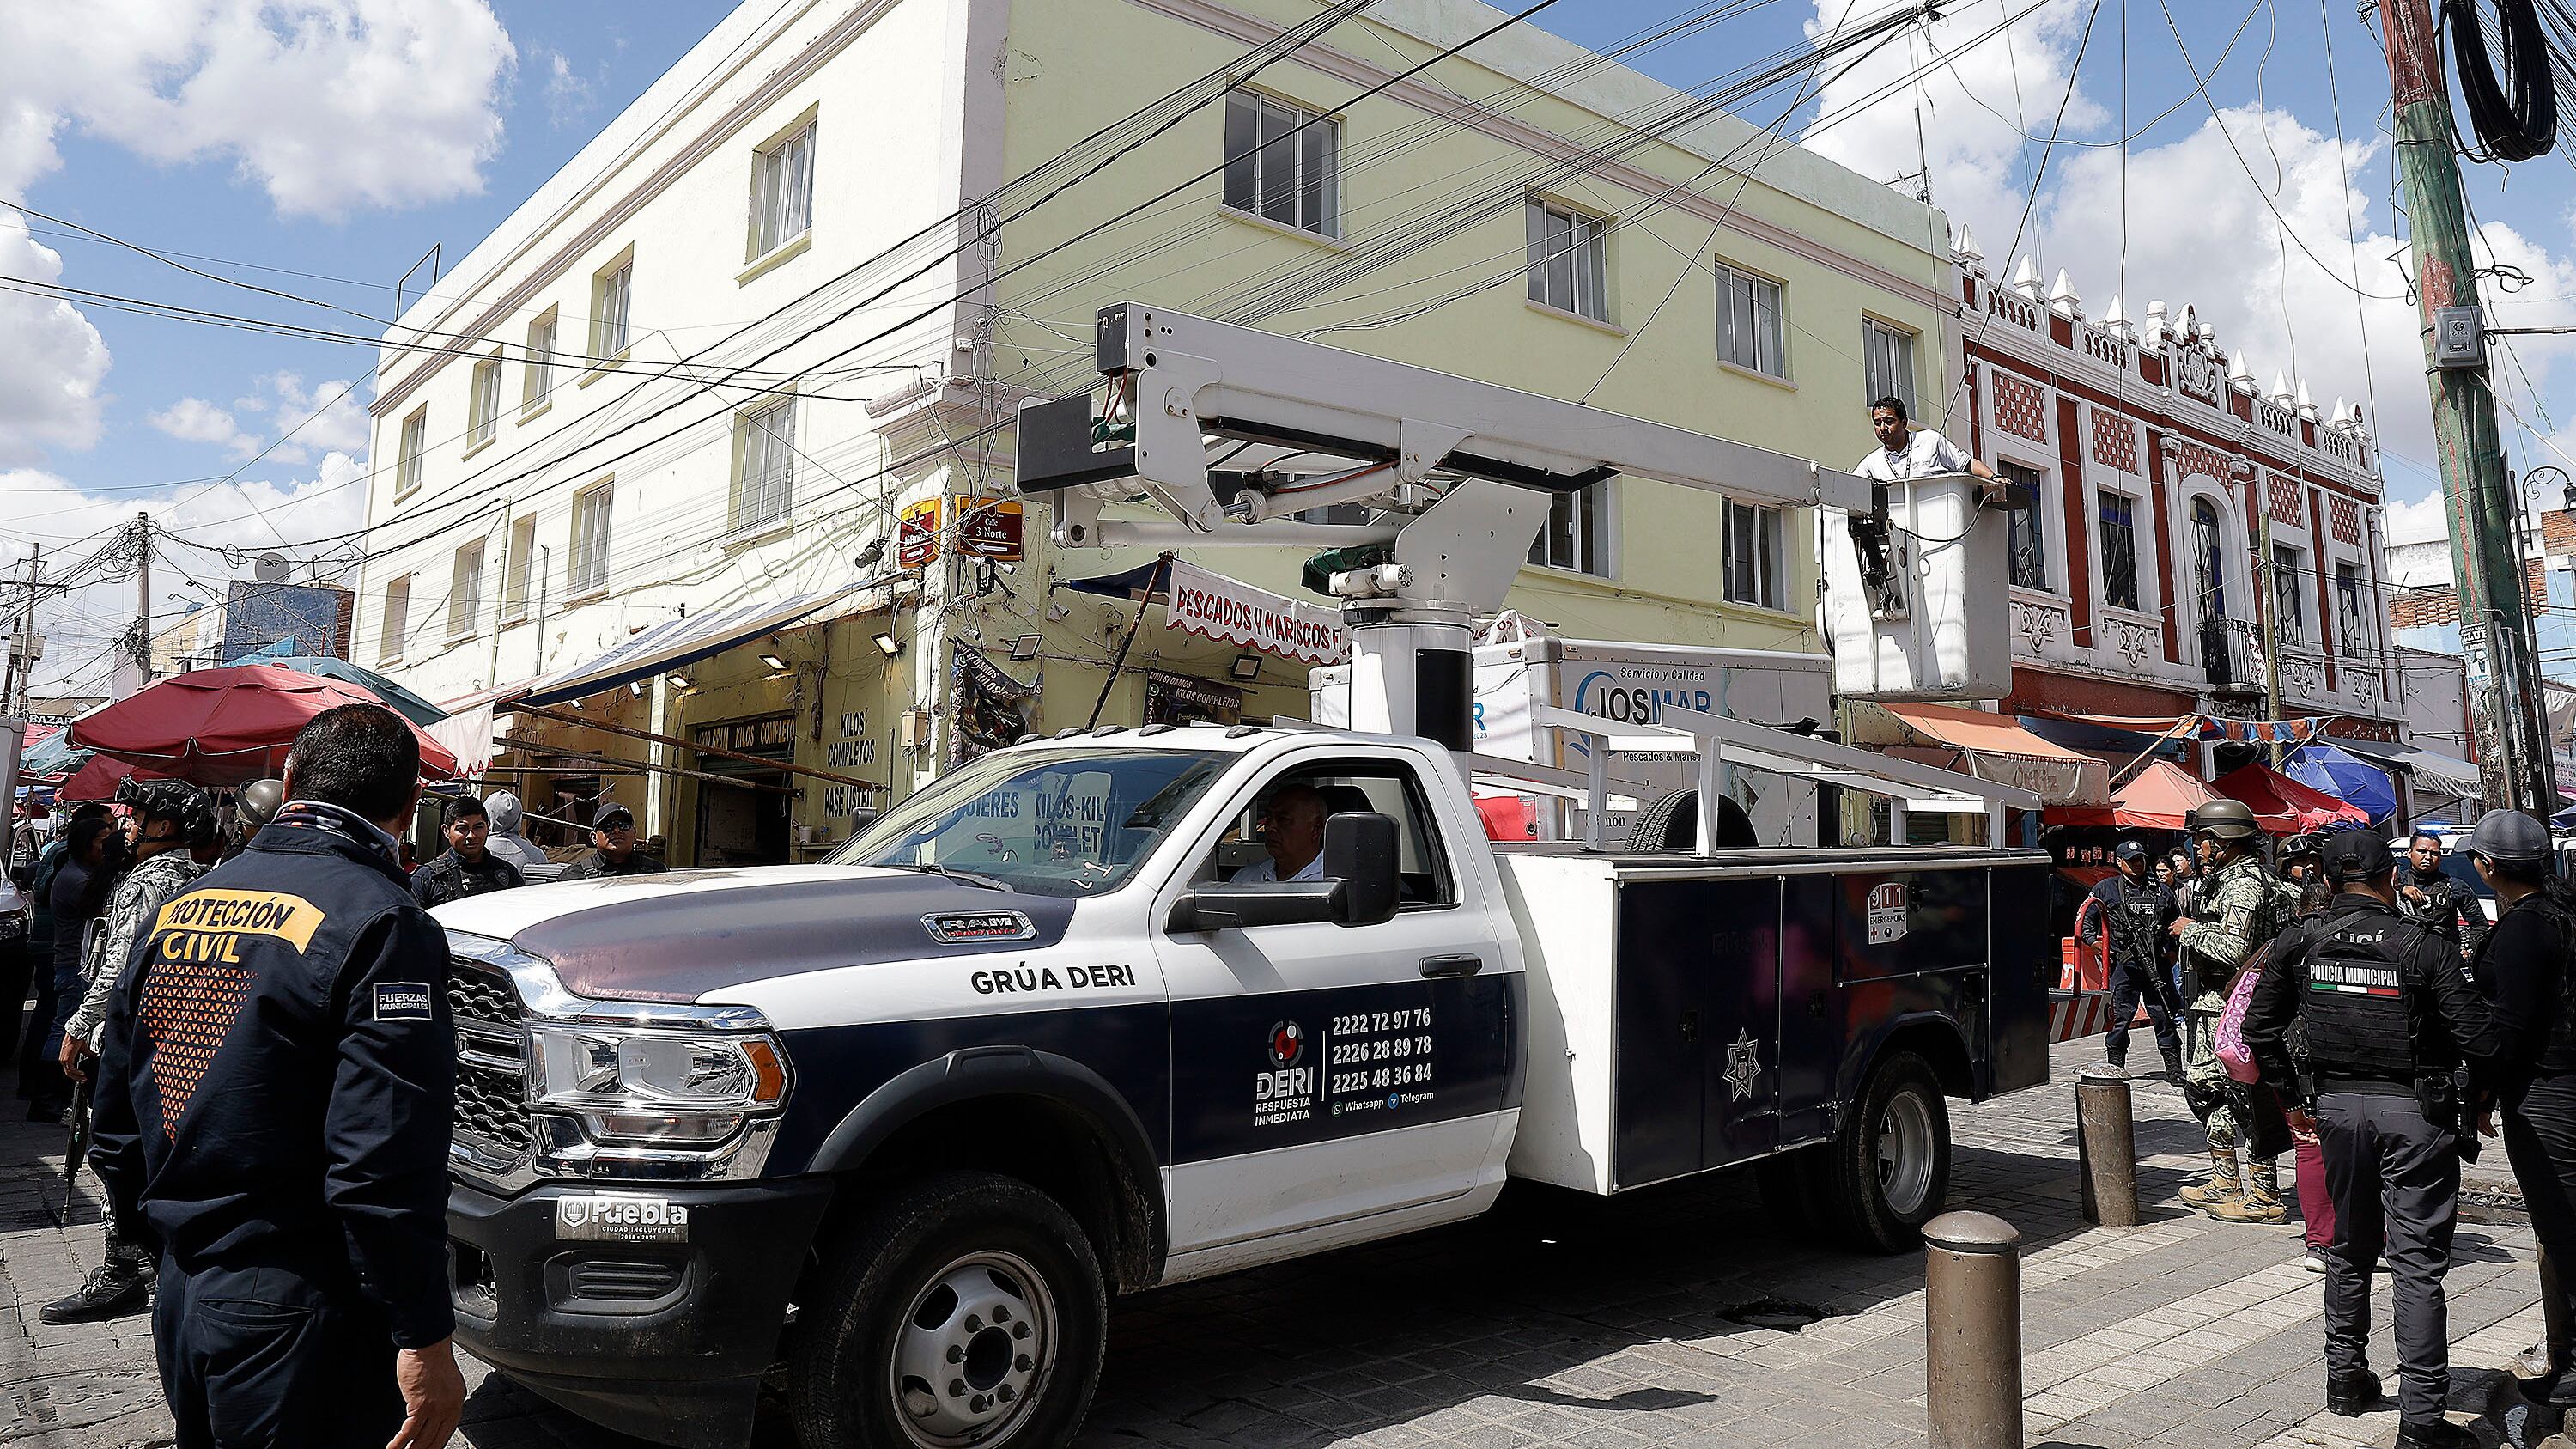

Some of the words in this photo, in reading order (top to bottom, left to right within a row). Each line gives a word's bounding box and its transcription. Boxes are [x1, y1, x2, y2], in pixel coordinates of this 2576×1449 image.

[975, 527, 981, 537] 3
[984, 527, 1007, 539] Norte
[985, 518, 999, 527] Calle
[1176, 584, 1252, 631] PESCADOS
[1254, 606, 1262, 636] Y
[1265, 610, 1331, 650] MARISCOS
[1620, 667, 1660, 679] Servicio
[1662, 671, 1668, 682] y
[1671, 668, 1705, 681] Calidad
[1176, 688, 1197, 701] KILOS
[1196, 692, 1240, 709] COMPLETOS
[840, 710, 865, 738] KILOS
[735, 724, 755, 749] KILOS
[827, 739, 876, 768] COMPLETOS
[1623, 752, 1663, 762] Pescados
[1666, 752, 1673, 762] &
[824, 786, 844, 817] PASE
[1870, 886, 1902, 907] 911
[942, 917, 1012, 929] RAM
[1869, 914, 1905, 925] EMERGENCIAS
[162, 931, 240, 964] CIVIL
[970, 961, 1063, 995] GRÚA
[1066, 965, 1136, 989] DERI
[2310, 961, 2344, 983] POLICÍA
[2345, 966, 2399, 987] MUNICIPAL
[379, 993, 428, 1004] FUERZAS
[380, 1002, 428, 1011] MUNICIPALES
[1333, 1014, 1369, 1036] 2222
[1372, 1012, 1390, 1032] 72
[1393, 1010, 1410, 1029] 97
[1413, 1008, 1431, 1027] 76
[1333, 1042, 1370, 1065] 2226
[1373, 1040, 1390, 1060] 28
[1394, 1038, 1411, 1057] 89
[1414, 1035, 1431, 1055] 78
[1256, 1066, 1314, 1100] DERI
[1332, 1070, 1368, 1093] 2225
[1372, 1068, 1390, 1087] 48
[1394, 1065, 1411, 1085] 36
[1414, 1062, 1432, 1082] 84
[1255, 1097, 1311, 1114] RESPUESTA
[1345, 1099, 1384, 1111] Whatsapp
[1400, 1091, 1434, 1105] Telegram
[1255, 1109, 1310, 1127] INMEDIATA
[592, 1200, 688, 1225] Puebla
